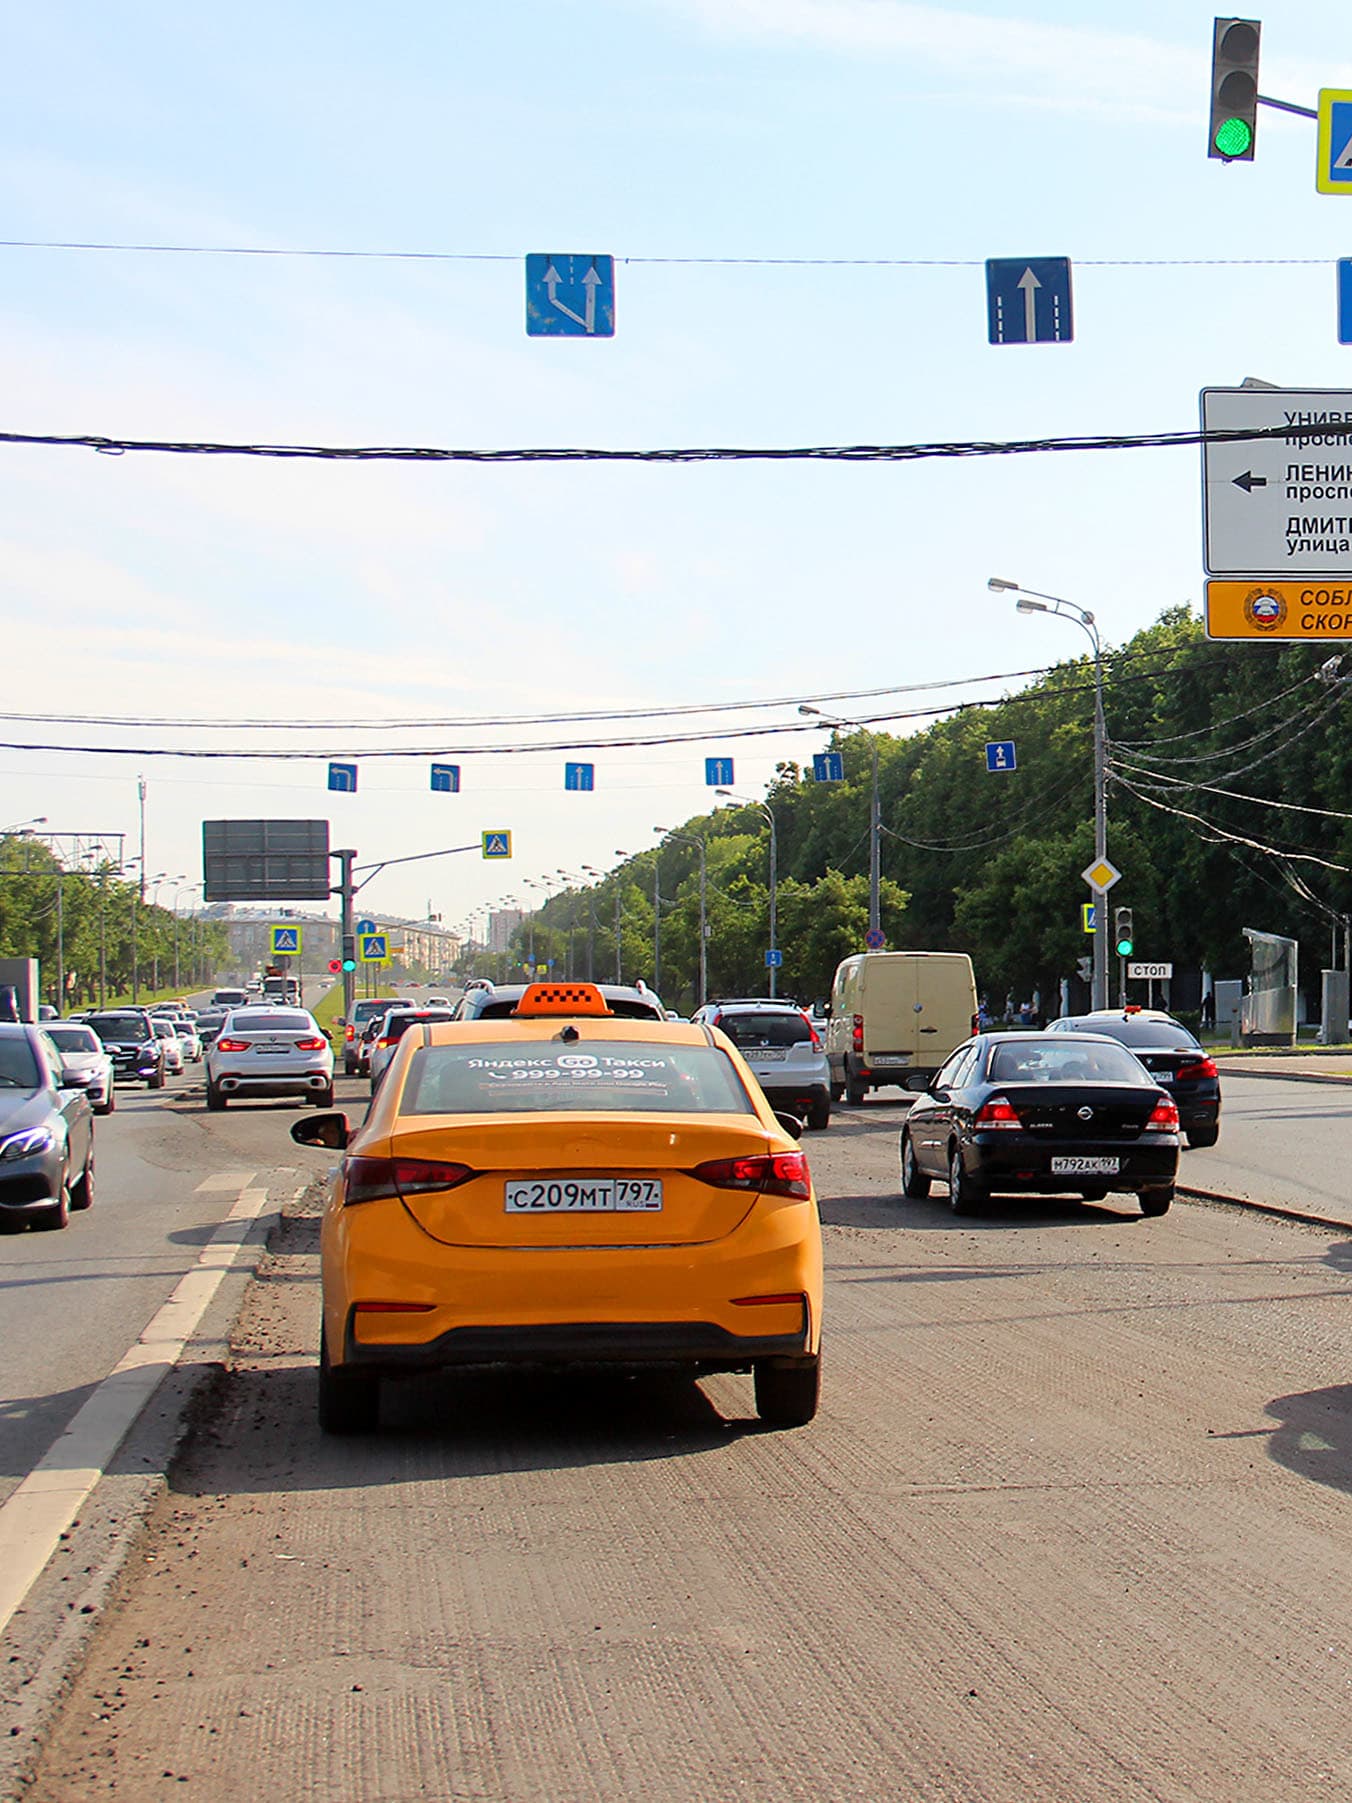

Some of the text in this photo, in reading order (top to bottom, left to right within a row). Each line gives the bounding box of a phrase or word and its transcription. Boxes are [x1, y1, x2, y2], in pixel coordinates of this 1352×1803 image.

[1287, 538, 1350, 556] улица
[1134, 965, 1166, 976] СТОП
[467, 1058, 552, 1069] Яндекс
[601, 1057, 666, 1068] Такси
[512, 1069, 645, 1079] 999-99-99
[513, 1182, 655, 1208] С209МТ 797
